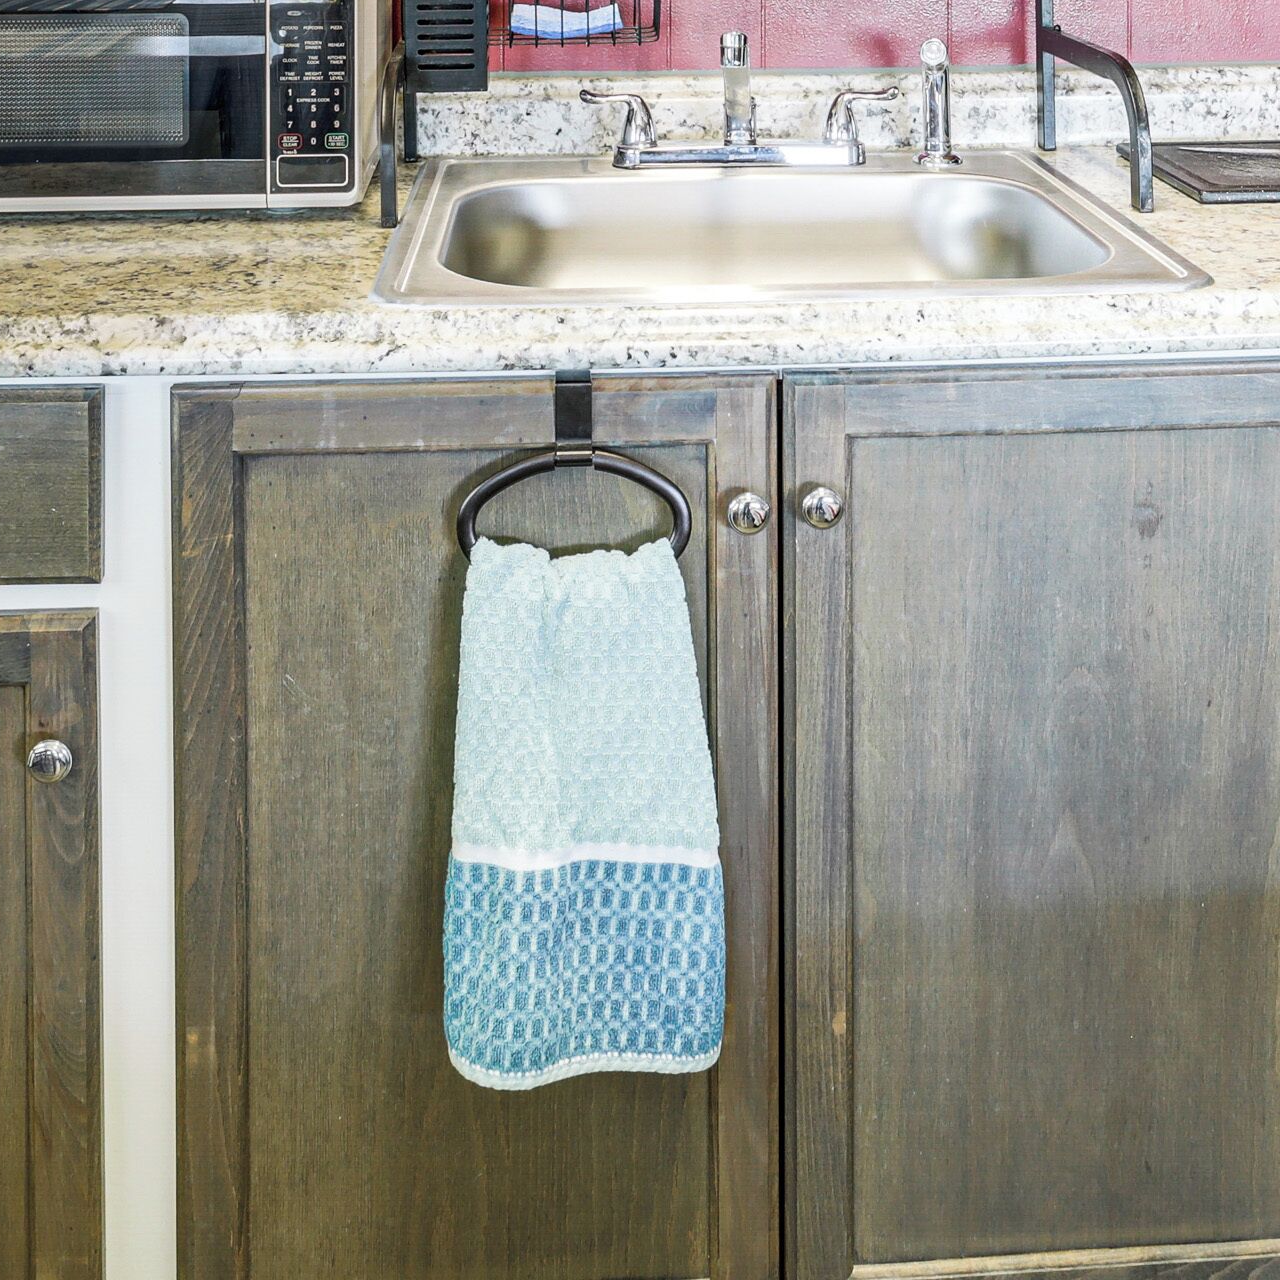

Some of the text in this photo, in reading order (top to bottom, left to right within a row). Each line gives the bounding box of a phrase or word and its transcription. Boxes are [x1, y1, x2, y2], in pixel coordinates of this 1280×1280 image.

[287, 88, 293, 96] 1
[310, 88, 317, 96] 2
[333, 88, 340, 96] 3
[287, 104, 293, 112] 4
[310, 104, 317, 112] 5
[333, 104, 340, 112] 6
[287, 120, 293, 129] 7
[310, 120, 317, 129] 8
[333, 120, 340, 129] 9
[310, 137, 317, 145] 0
